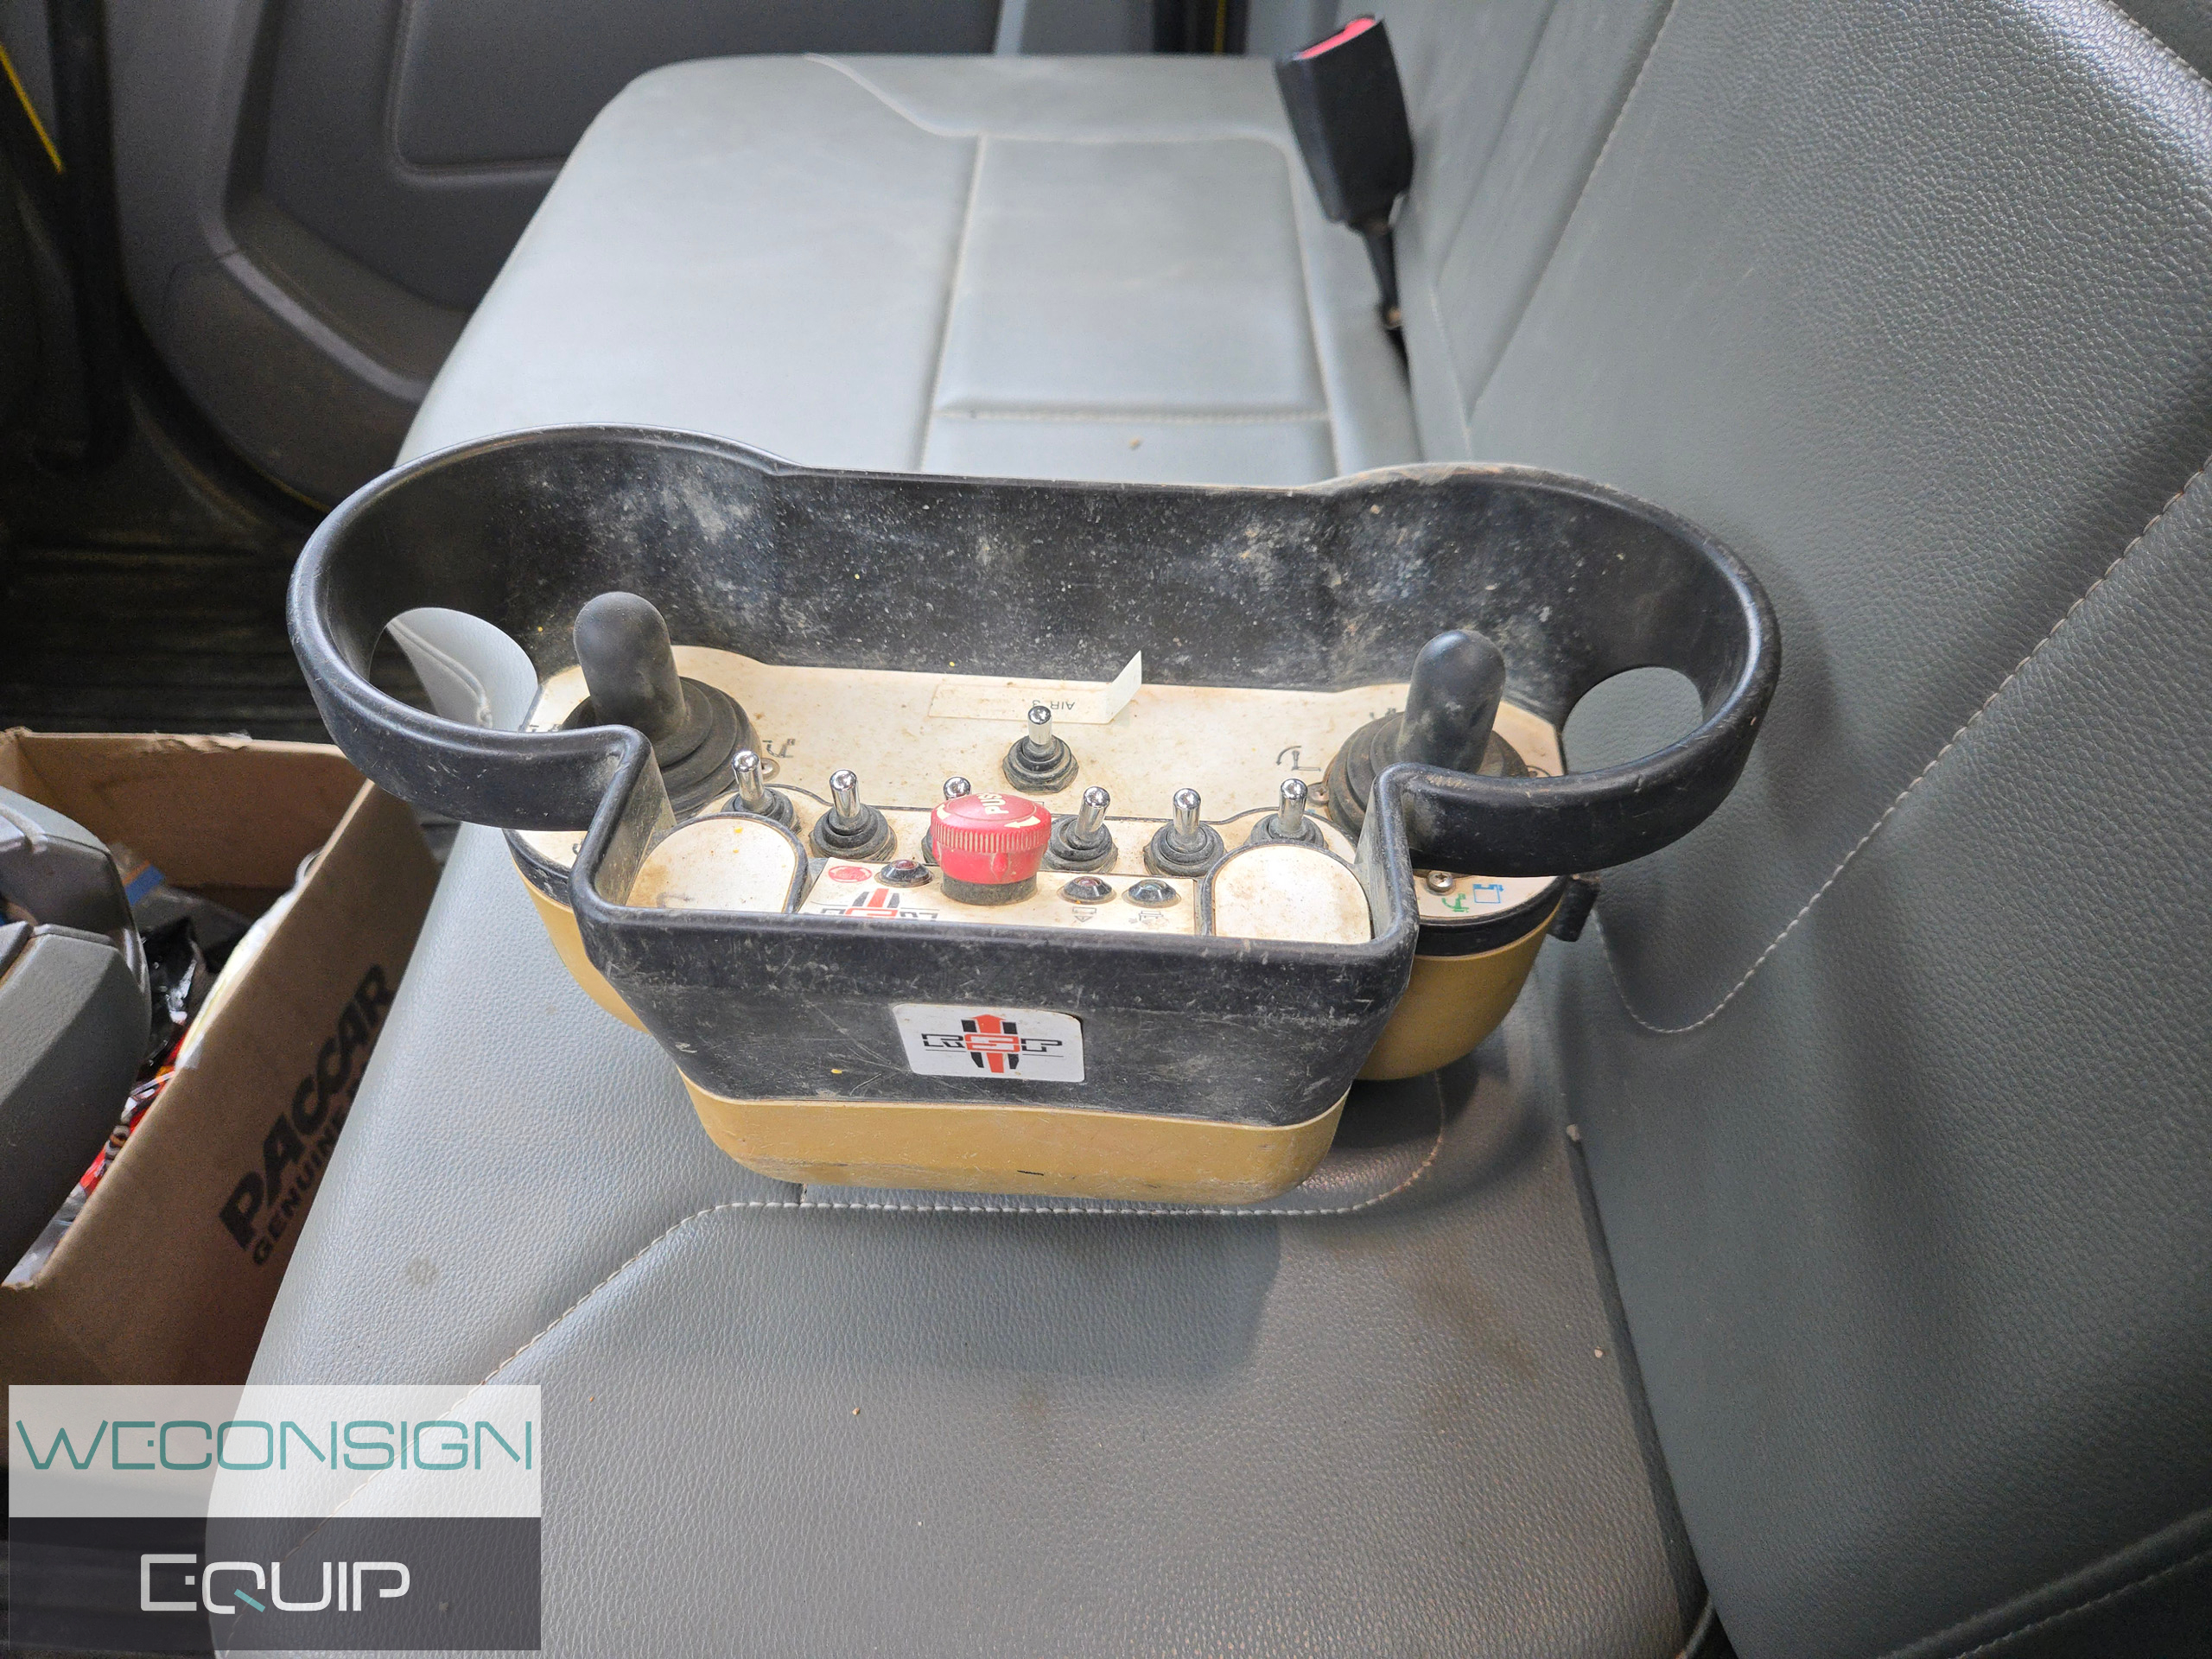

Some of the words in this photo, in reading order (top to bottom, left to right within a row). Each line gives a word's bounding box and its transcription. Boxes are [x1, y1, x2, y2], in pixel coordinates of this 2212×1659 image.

[1050, 701, 1076, 710] AIR
[976, 792, 1009, 815] PUS
[219, 964, 397, 1251] PACCAR
